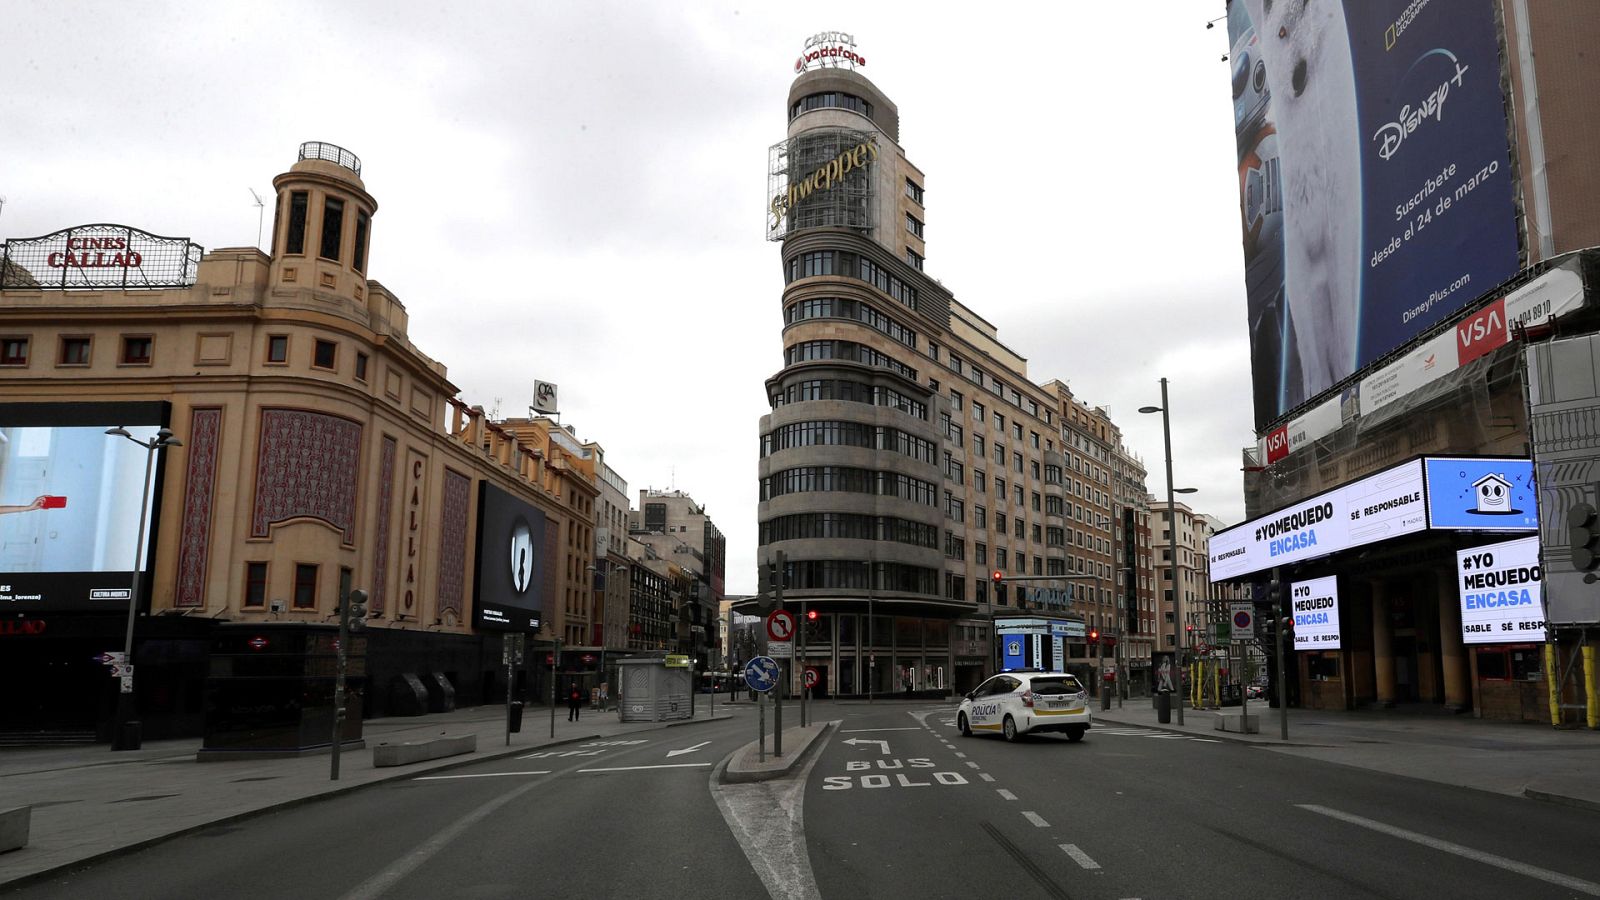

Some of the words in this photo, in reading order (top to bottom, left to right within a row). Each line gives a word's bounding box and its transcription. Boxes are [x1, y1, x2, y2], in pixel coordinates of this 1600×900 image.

[804, 31, 858, 49] CAPITOL
[804, 46, 866, 66] vodafone
[770, 135, 879, 231] Schweppes
[1395, 163, 1457, 221] Suscríbete
[1371, 237, 1401, 268] desde
[1404, 221, 1414, 241] el
[1417, 209, 1432, 231] 24
[1435, 195, 1451, 216] de
[1455, 160, 1498, 201] marzo
[67, 237, 126, 250] CINES
[47, 252, 142, 268] CALLAO
[1402, 273, 1471, 324] DisneyPlus.com
[1460, 310, 1502, 347] VSA
[1267, 428, 1287, 452] VSA
[1364, 491, 1420, 517] RESPONSABLE
[1255, 501, 1333, 542] #YOMEQUEDO
[404, 459, 421, 610] CALLAO
[1269, 529, 1318, 557] ENCASA
[1218, 546, 1246, 561] RESPONSABLE
[1463, 553, 1493, 570] #YO
[1464, 566, 1542, 590] MEQUEDO
[1294, 586, 1310, 597] #YO
[1465, 589, 1532, 610] ENCASA
[1295, 597, 1334, 611] MEQUEDO
[1296, 612, 1328, 626] ENCASA
[1464, 624, 1491, 633] SABLE
[846, 758, 936, 771] BUS
[822, 772, 969, 791] SOLO
